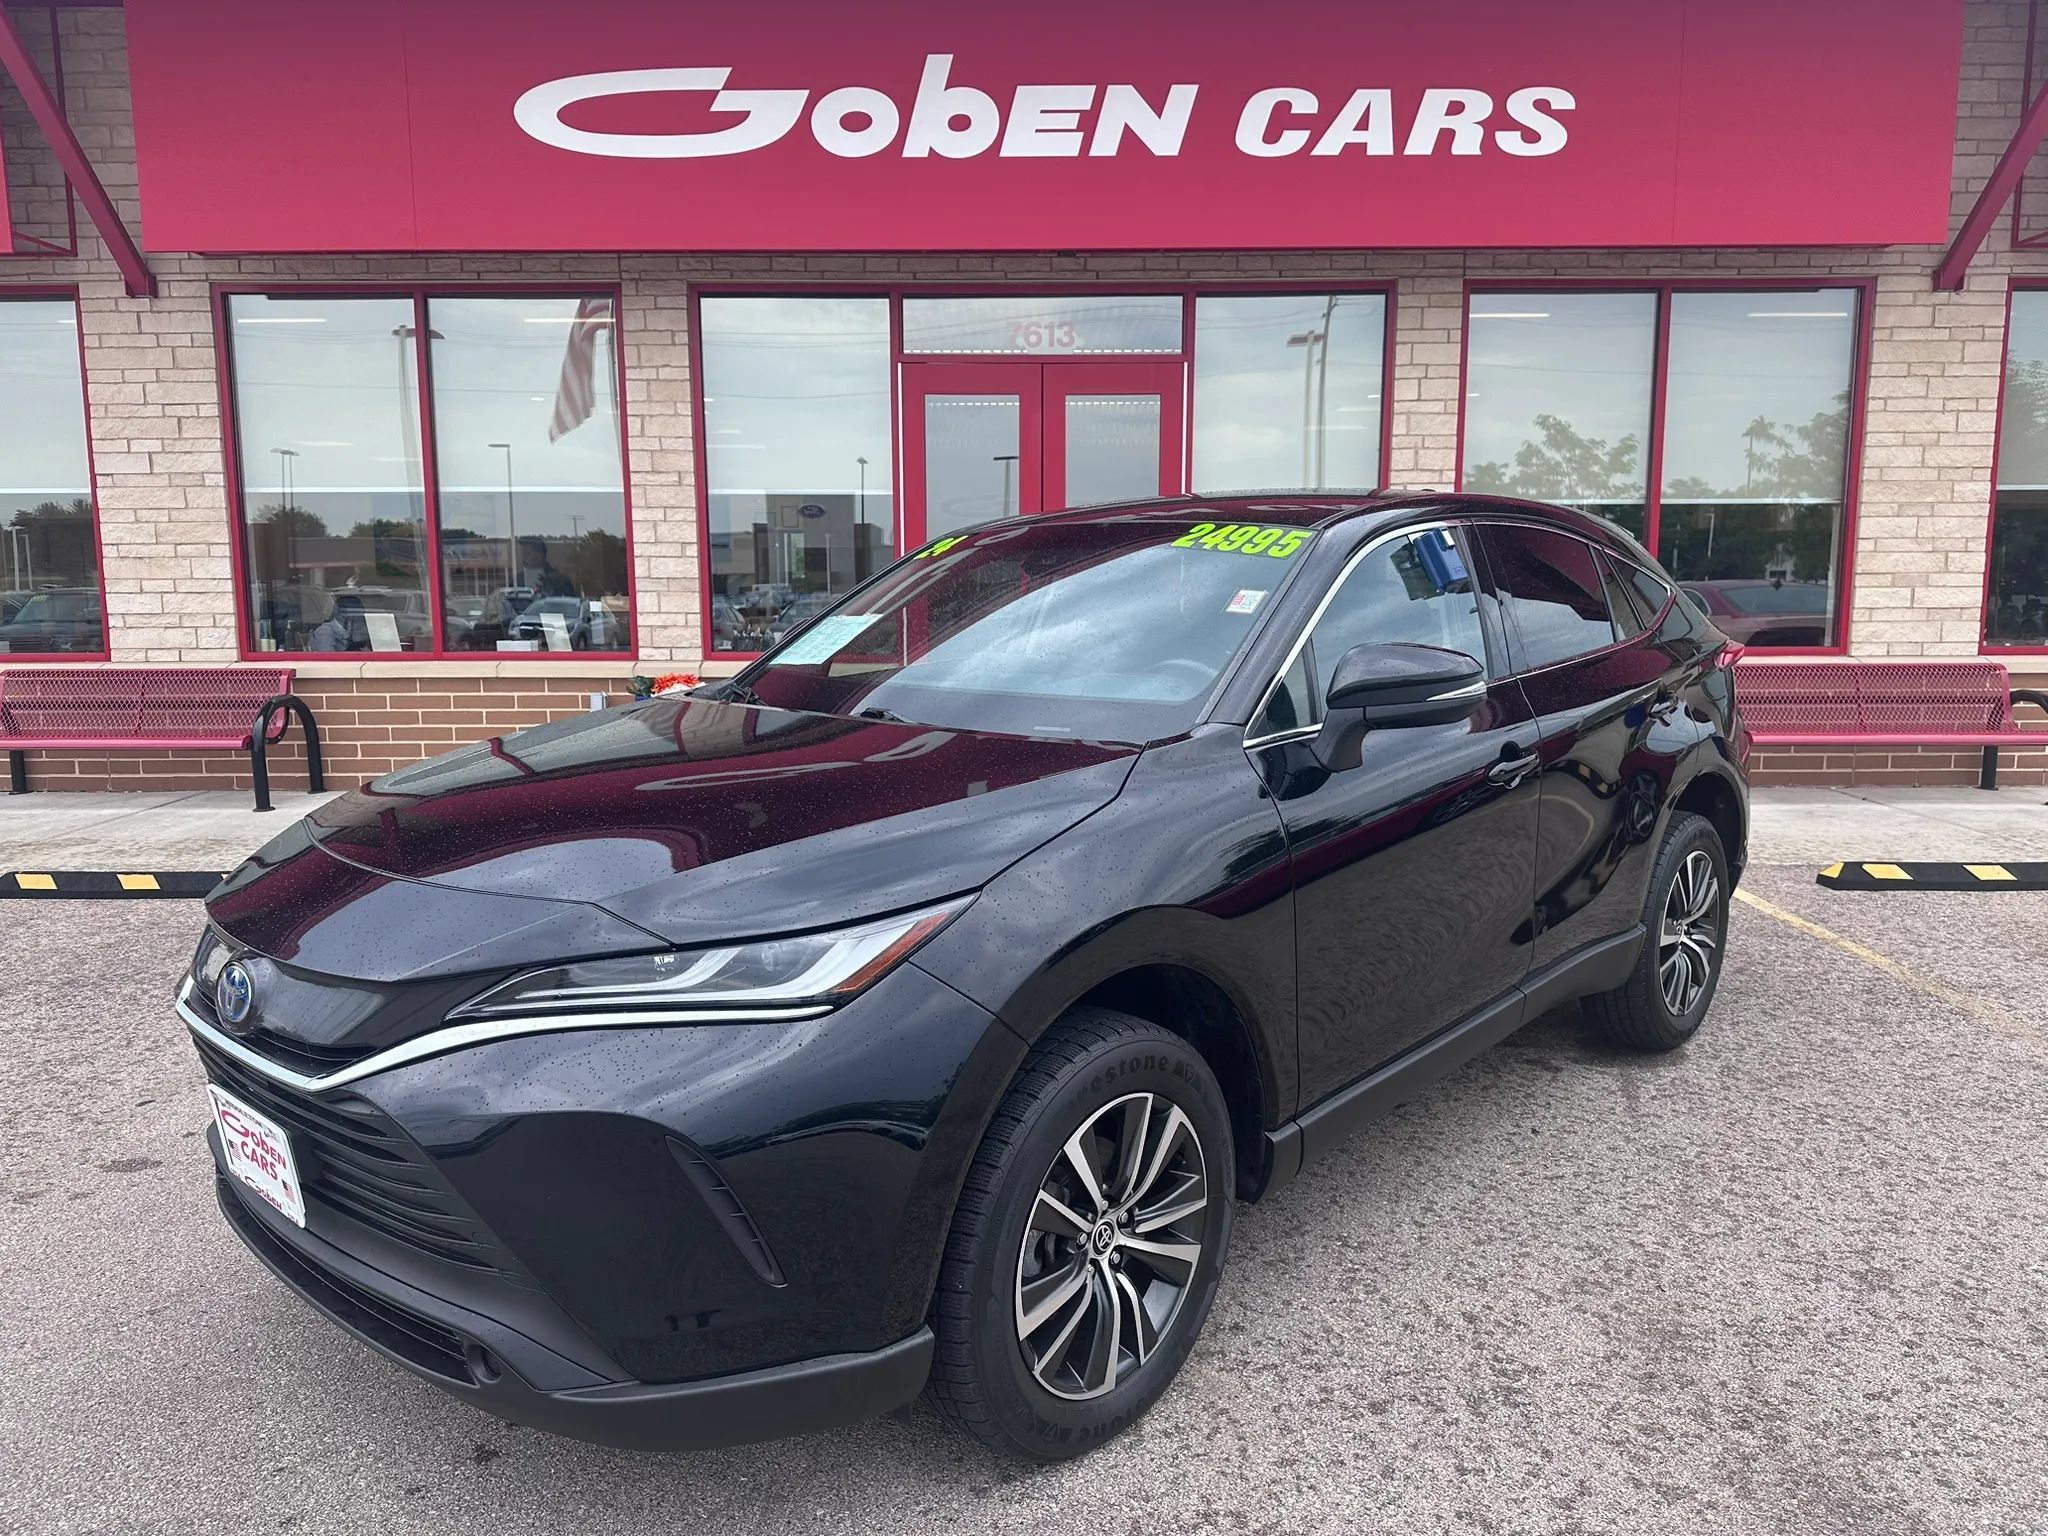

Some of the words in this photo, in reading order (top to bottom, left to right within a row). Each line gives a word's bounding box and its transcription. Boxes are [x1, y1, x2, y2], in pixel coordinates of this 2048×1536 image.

[513, 53, 1200, 158] GobEN
[1234, 86, 1577, 158] CARS
[1008, 319, 1076, 348] 7613
[1170, 522, 1313, 558] 24995
[240, 1140, 278, 1181] CARS
